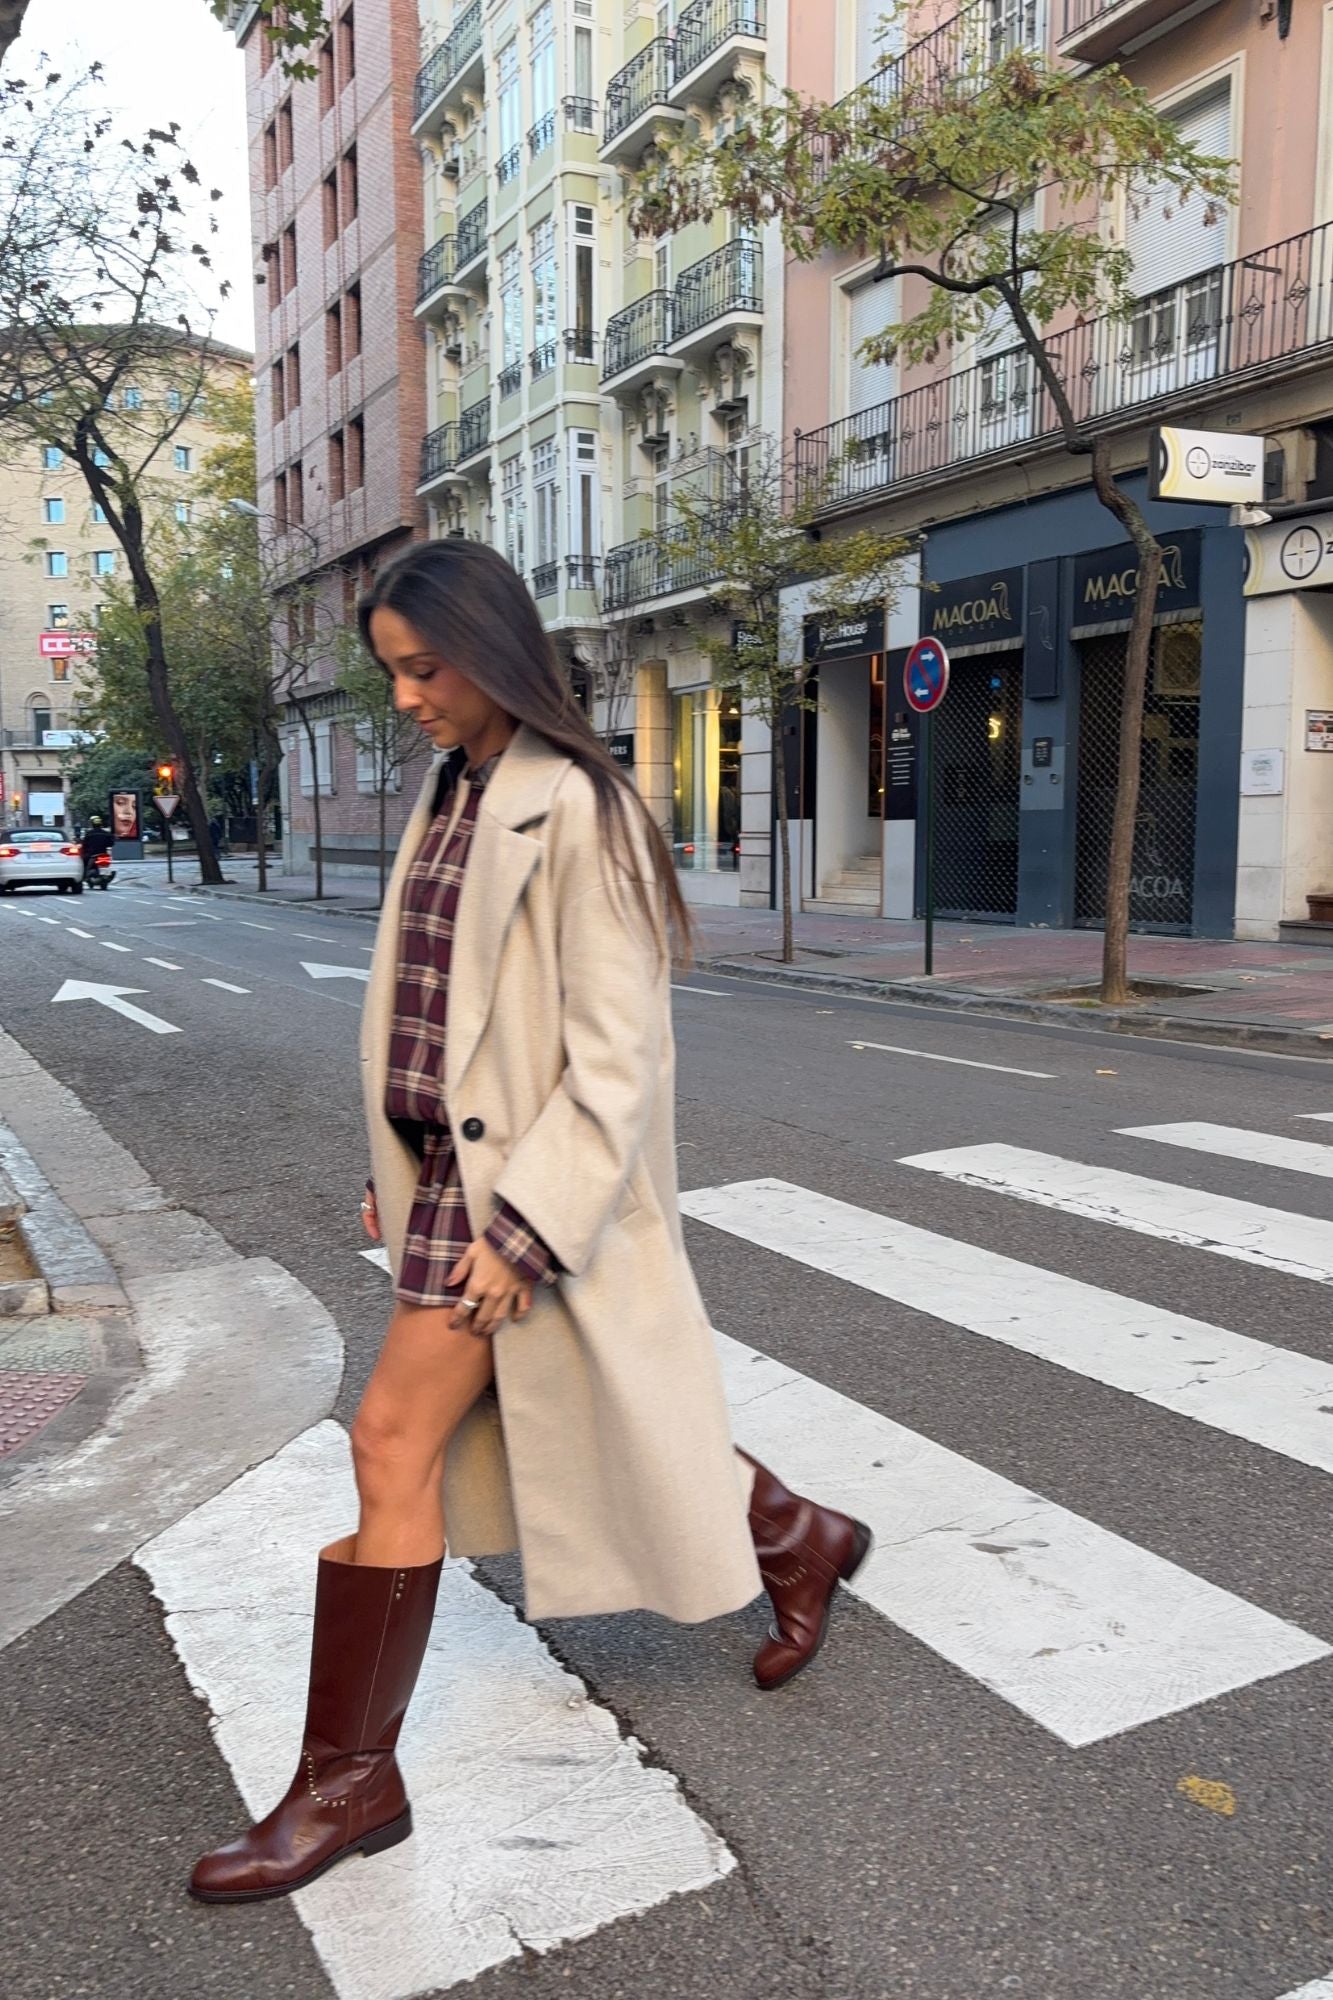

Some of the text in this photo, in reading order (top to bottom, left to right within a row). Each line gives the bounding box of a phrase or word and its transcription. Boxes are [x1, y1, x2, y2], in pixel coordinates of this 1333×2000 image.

[1212, 459, 1257, 472] zanzibar
[1084, 563, 1172, 603] MACA
[932, 598, 1000, 631] MACOA
